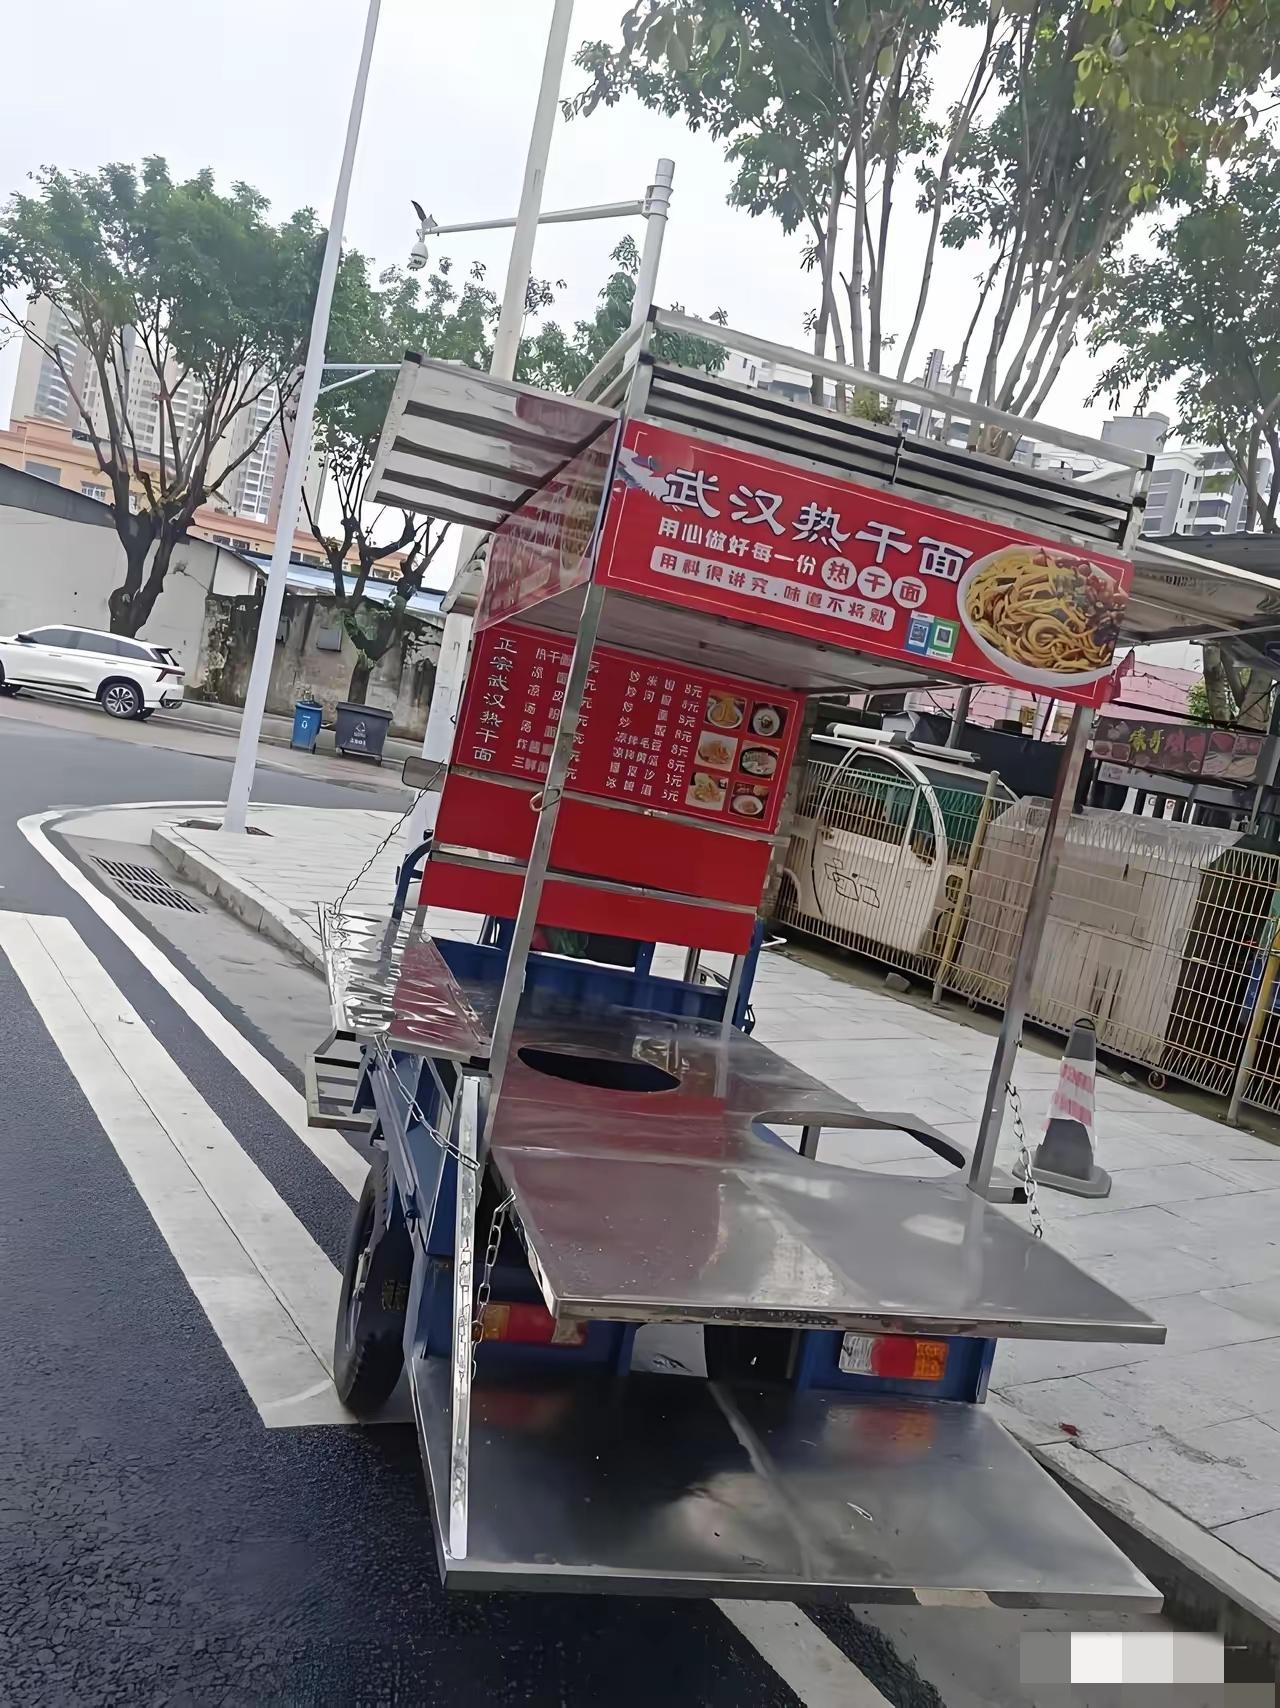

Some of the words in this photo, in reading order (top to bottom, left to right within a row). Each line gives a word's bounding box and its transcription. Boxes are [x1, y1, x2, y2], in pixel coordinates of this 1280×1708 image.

[663, 467, 974, 583] 武汉热干面
[670, 743, 689, 758] 8元
[667, 759, 686, 773] 8元
